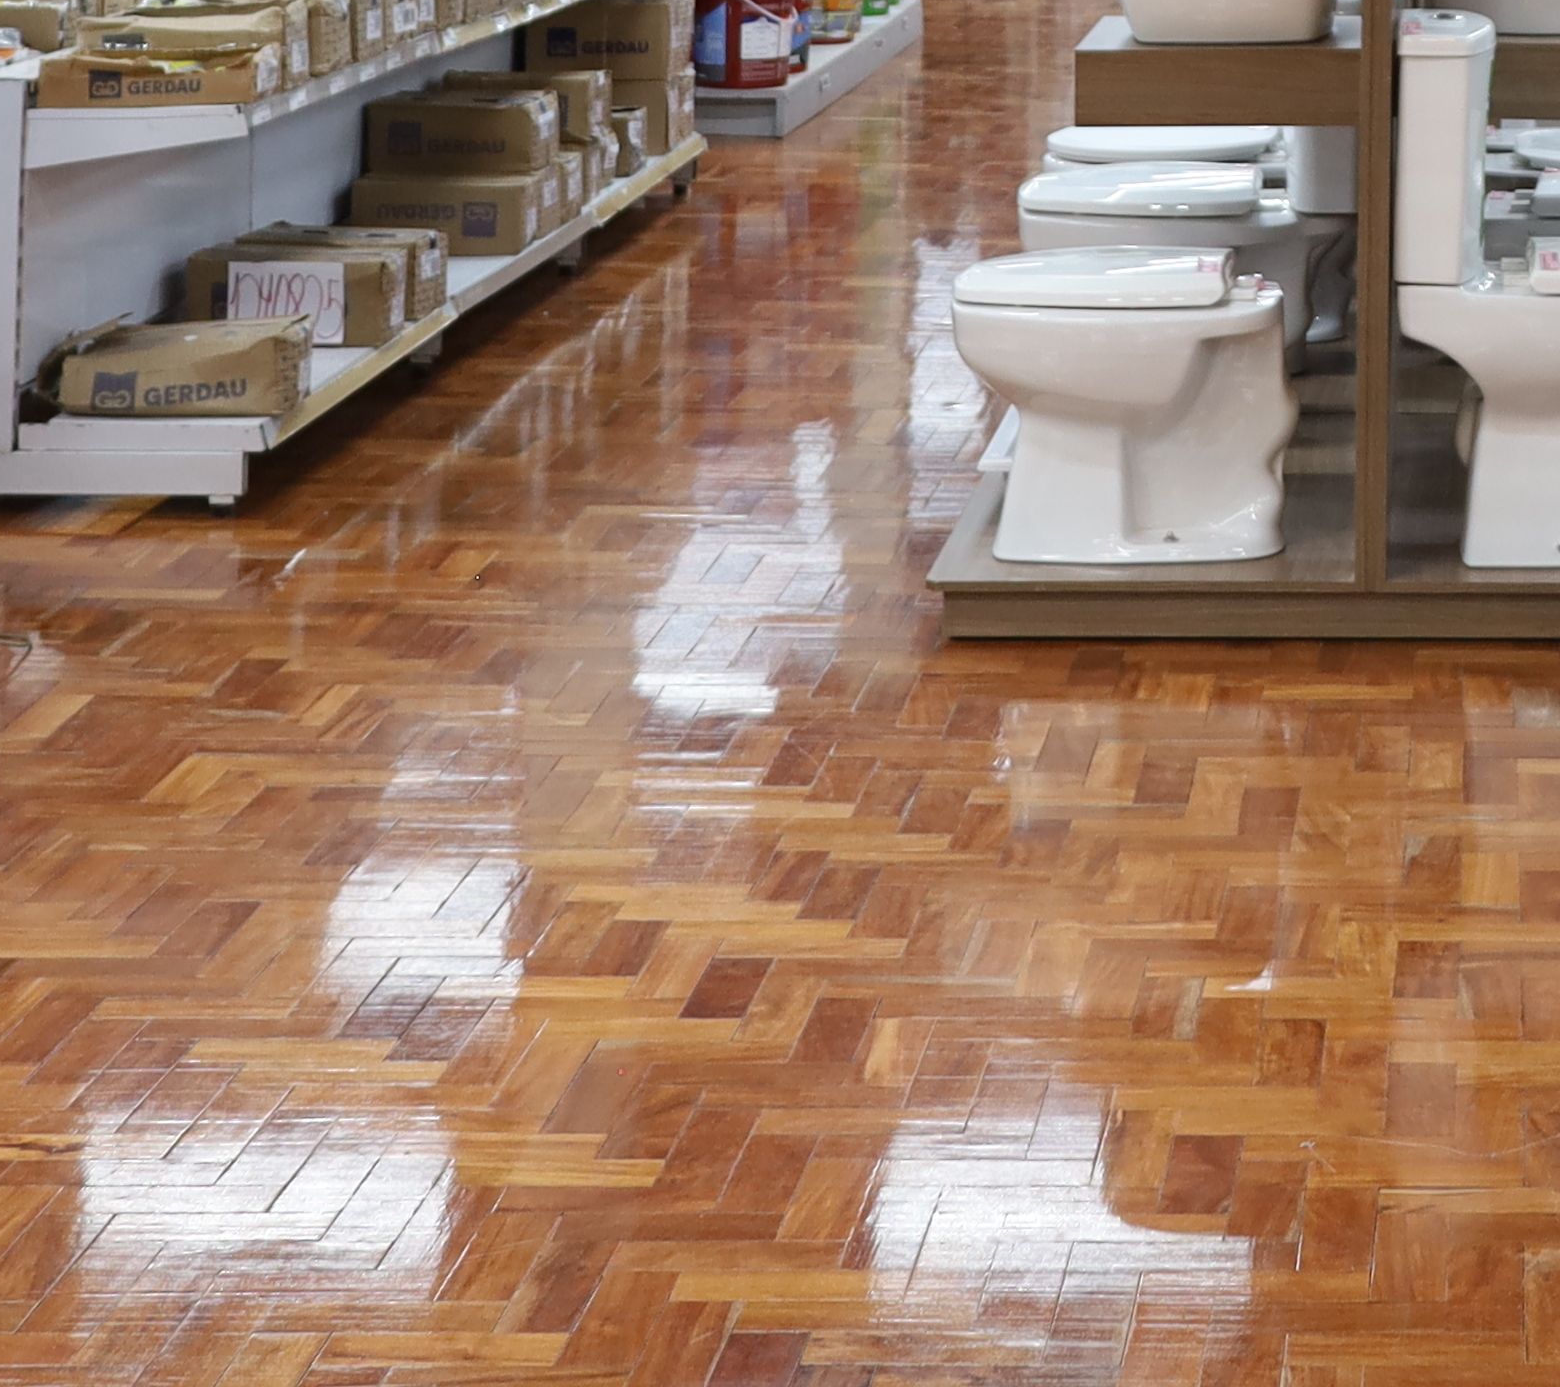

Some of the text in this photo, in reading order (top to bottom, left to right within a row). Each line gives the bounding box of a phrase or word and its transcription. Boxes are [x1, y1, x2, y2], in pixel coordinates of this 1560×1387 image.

[582, 41, 649, 54] GERDAU
[128, 79, 201, 94] GERDAU
[144, 378, 247, 407] GERDAU
